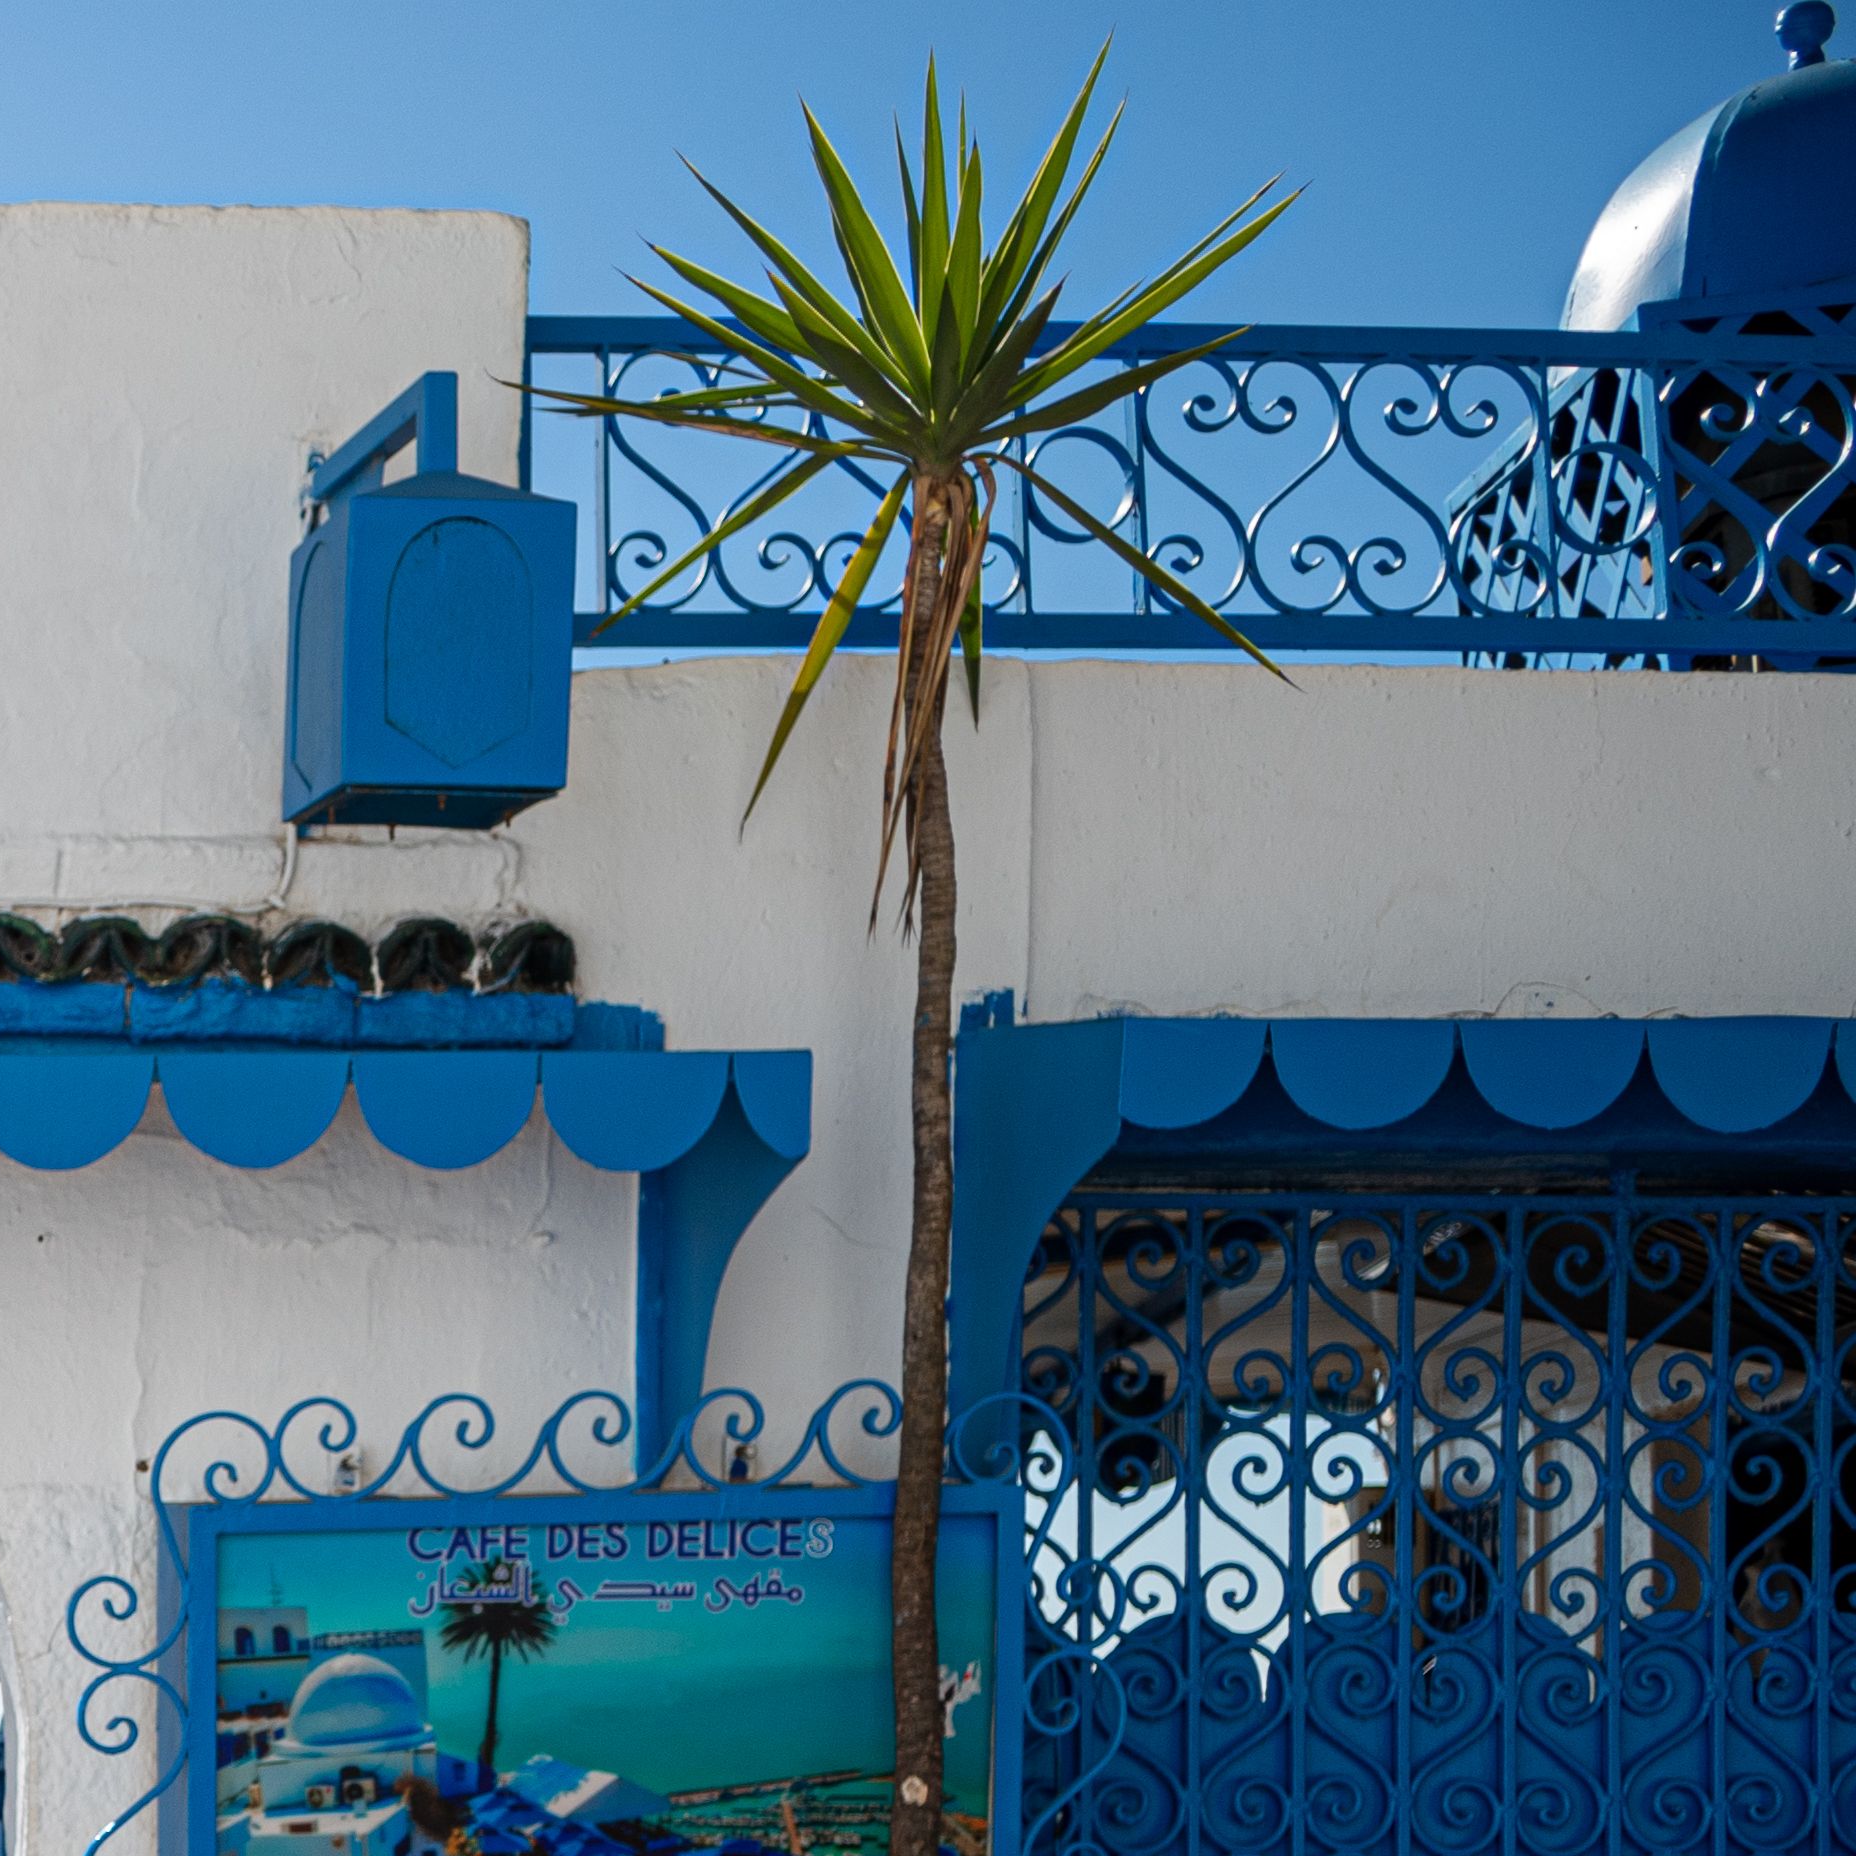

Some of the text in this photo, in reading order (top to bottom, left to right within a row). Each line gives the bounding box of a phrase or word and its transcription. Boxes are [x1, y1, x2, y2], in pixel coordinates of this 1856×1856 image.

[407, 1519, 837, 1562] CAFE DES DELICES
[704, 1568, 804, 1613] مقهى
